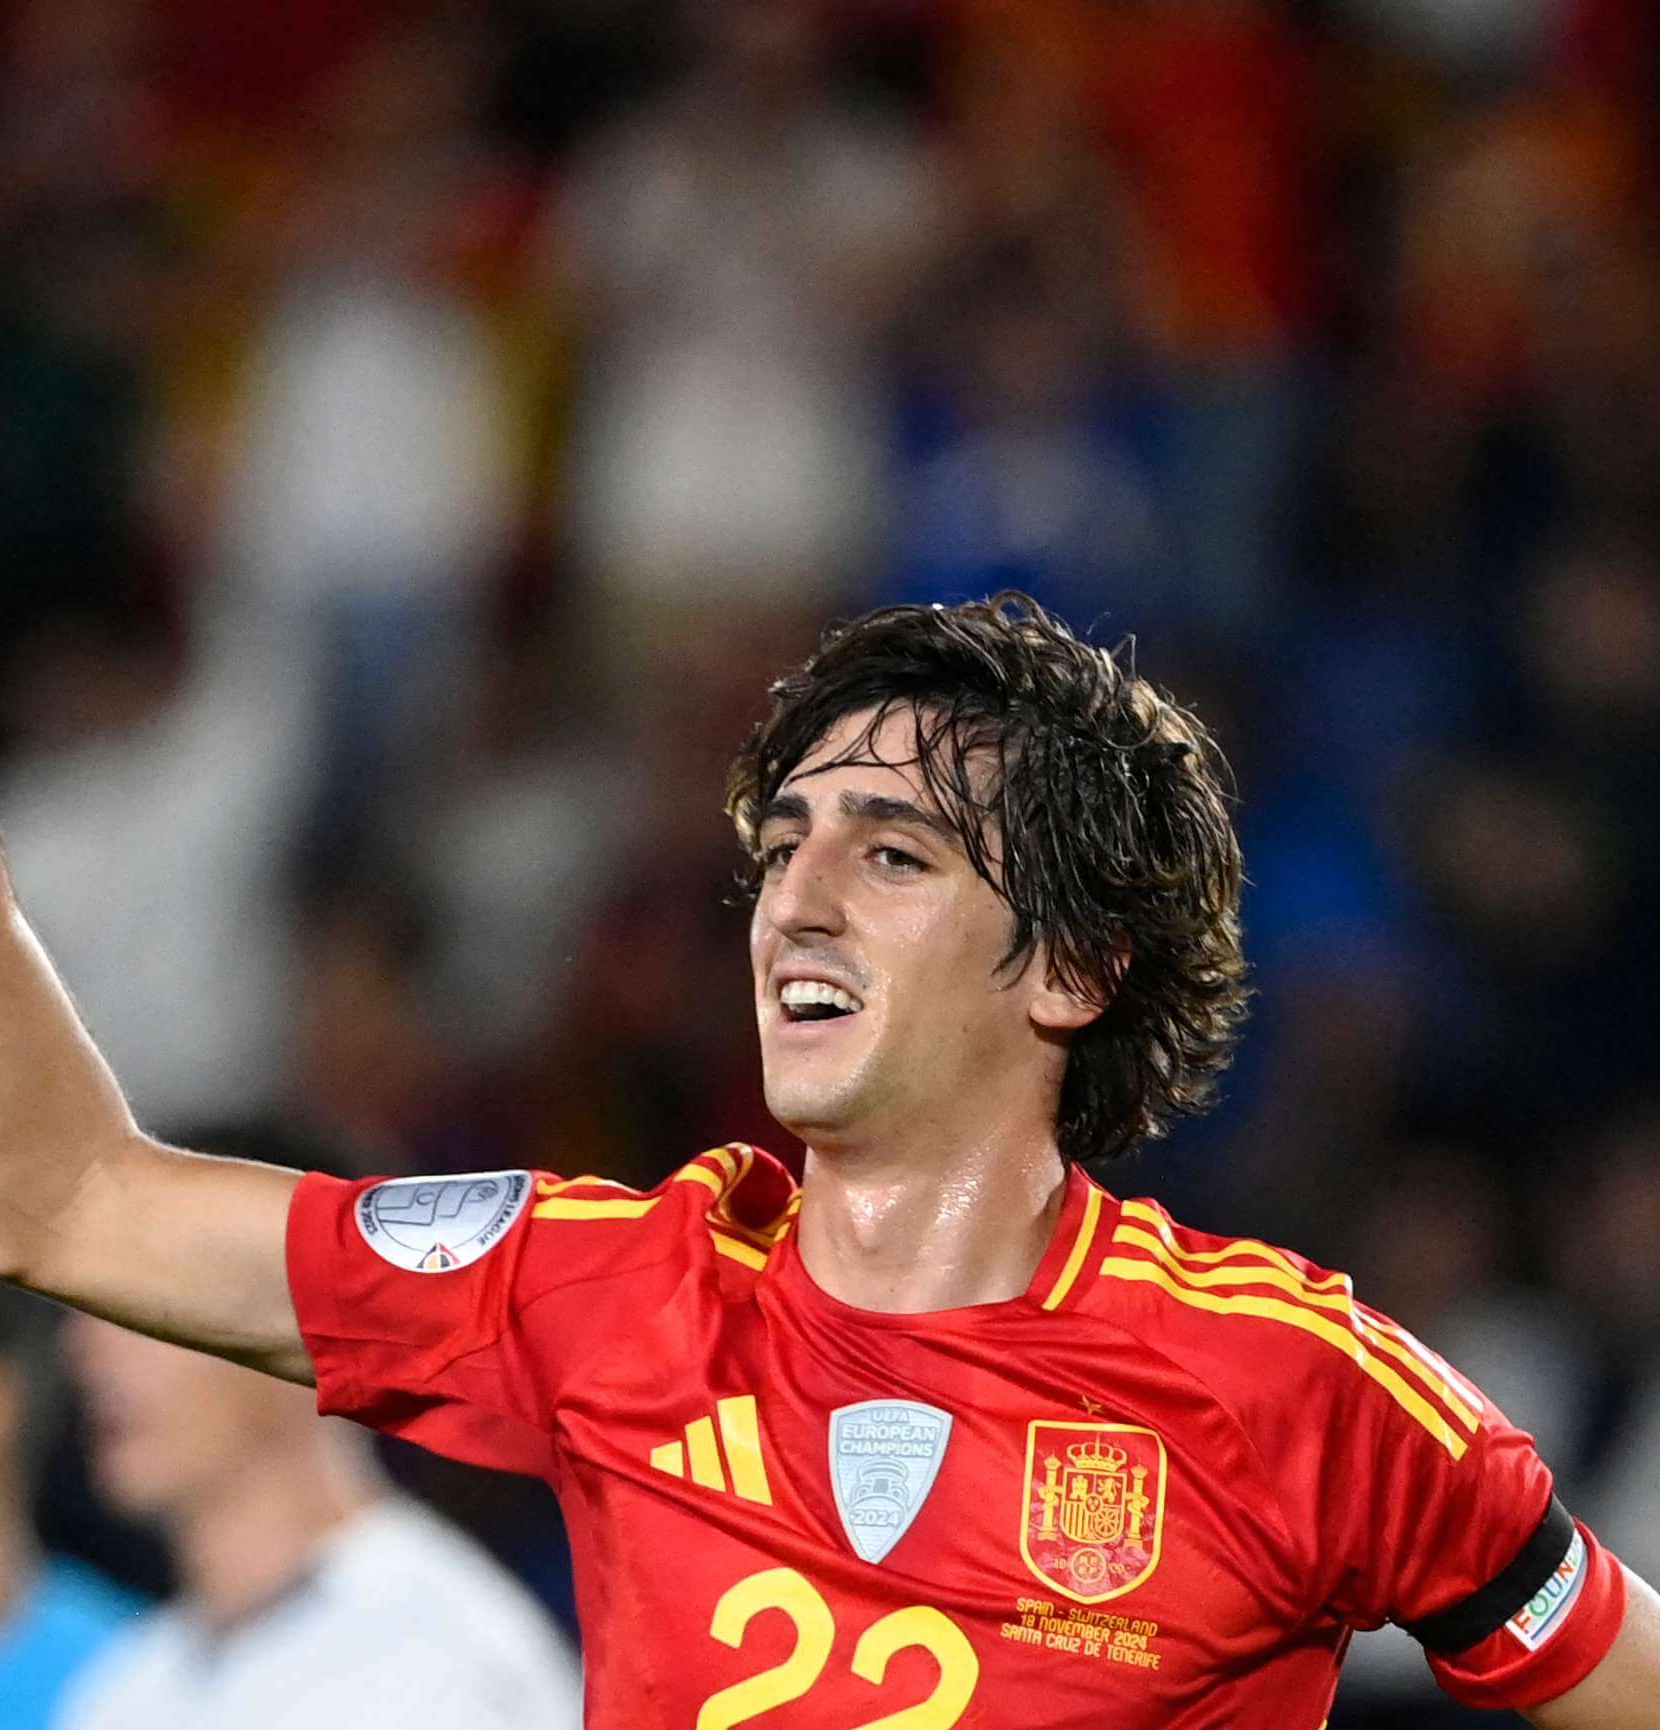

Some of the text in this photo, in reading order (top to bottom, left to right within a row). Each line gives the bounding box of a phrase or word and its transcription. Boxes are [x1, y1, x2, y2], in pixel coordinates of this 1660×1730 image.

[872, 1409, 909, 1424] UEFA
[841, 1424, 936, 1441] EUROPEAN
[840, 1440, 934, 1457] CHAMPIONS
[853, 1509, 900, 1526] 2024
[1016, 1597, 1055, 1617] SPAIN
[1068, 1607, 1158, 1637] SWITZERLAND
[1021, 1614, 1148, 1651] 18 NOVEMBER 2024
[1000, 1622, 1162, 1671] SANTA CRUZ DE TENERIFE
